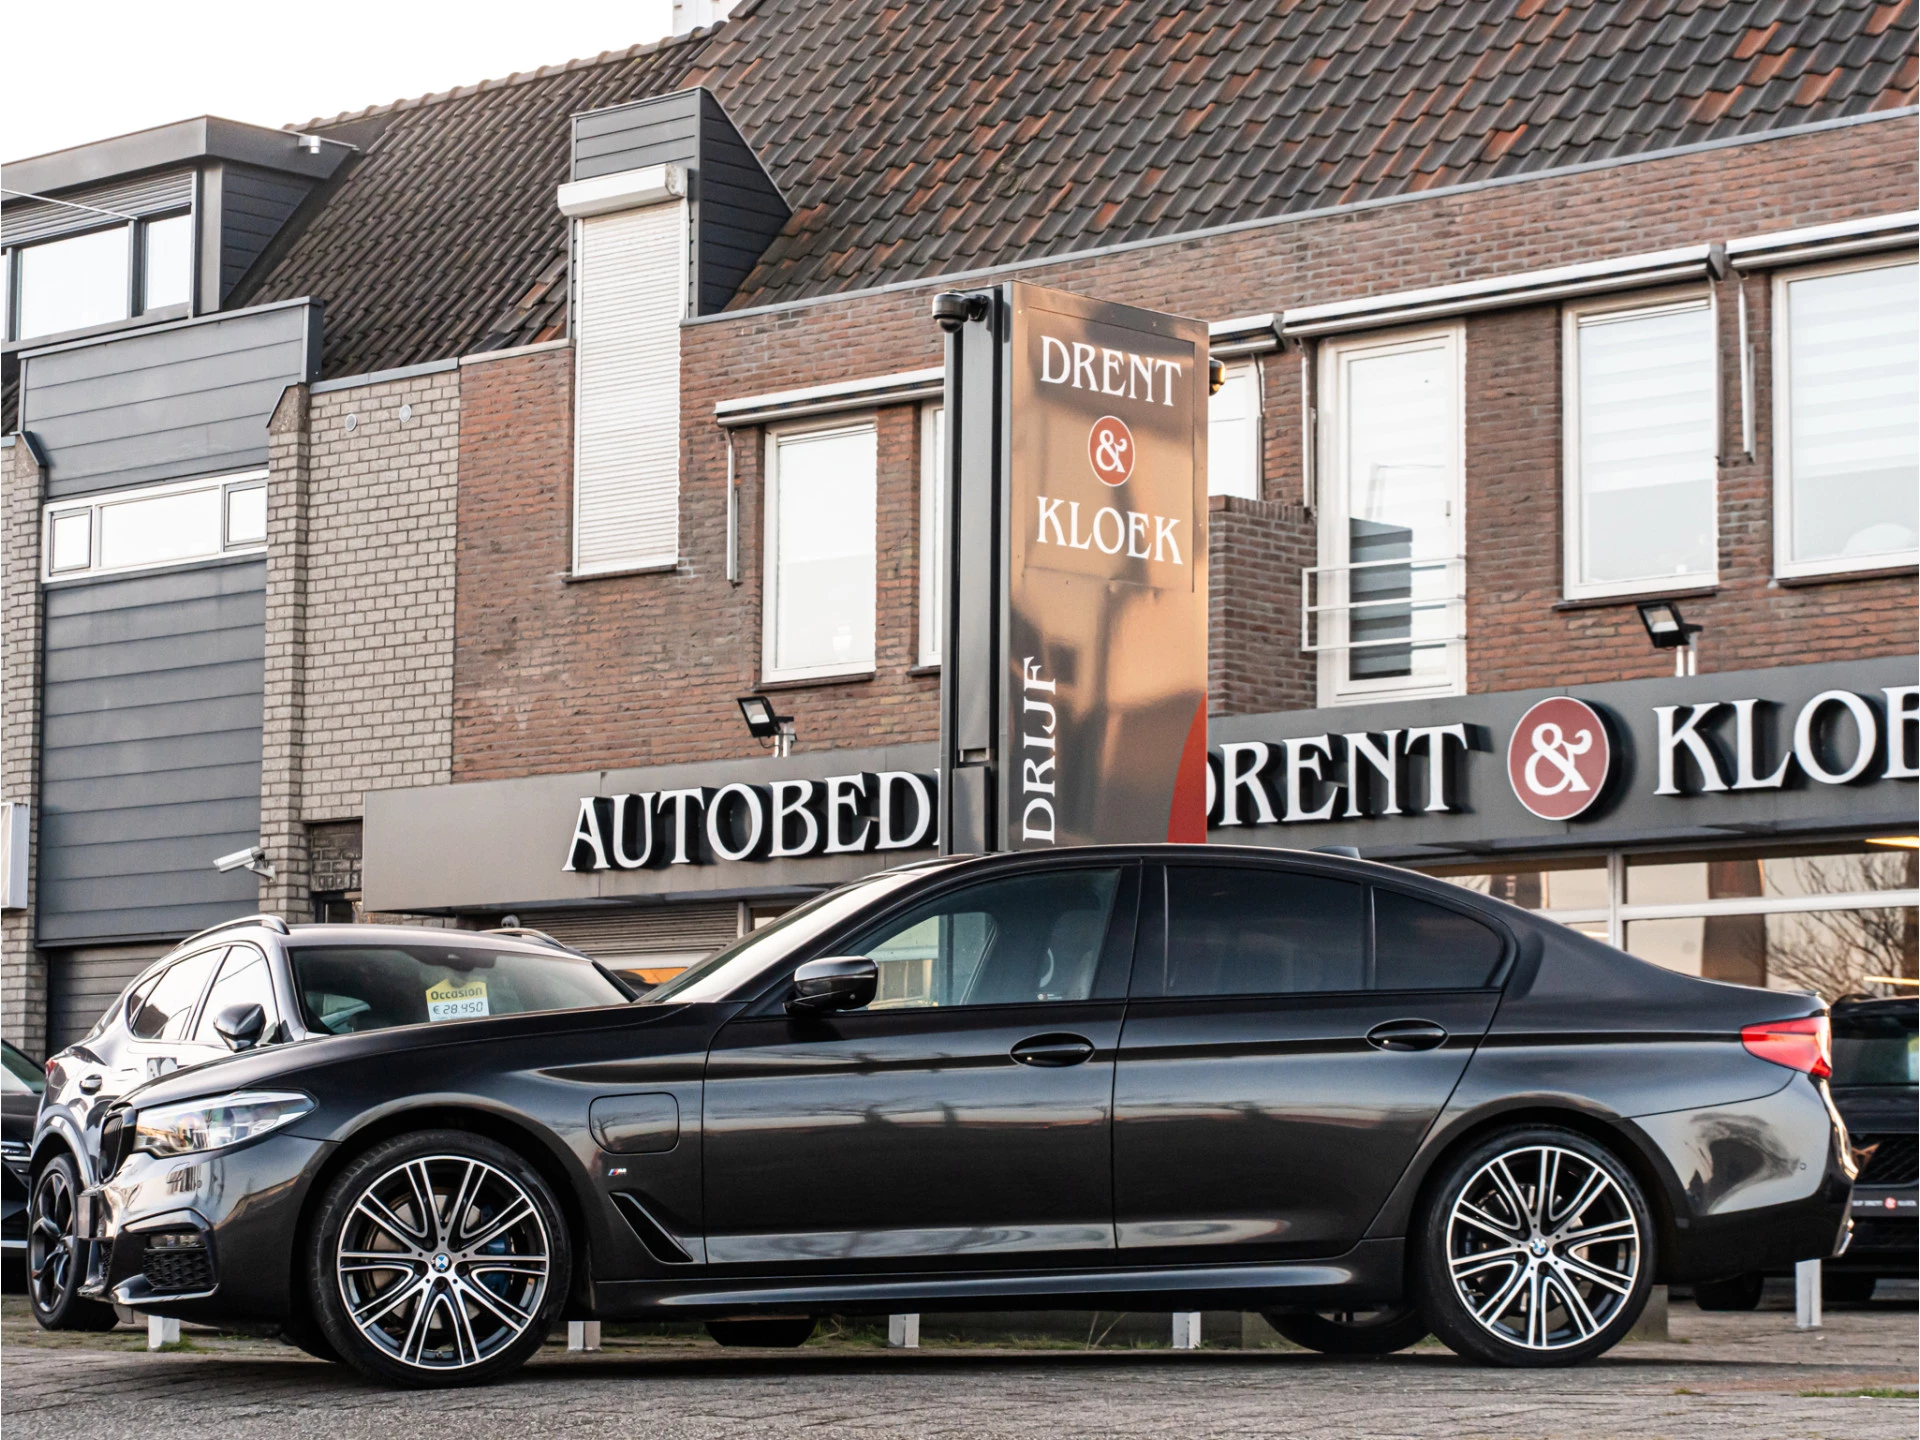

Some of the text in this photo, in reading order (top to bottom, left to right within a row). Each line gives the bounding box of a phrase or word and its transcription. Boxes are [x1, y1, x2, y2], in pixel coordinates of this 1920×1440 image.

[1040, 335, 1182, 406] DRENT
[1095, 429, 1128, 473] &
[1037, 496, 1183, 564] KLOEK
[1022, 656, 1057, 844] DRIJF
[562, 768, 939, 871] AUTOBED
[1206, 723, 1468, 826] RENT
[1524, 722, 1593, 796] &
[430, 987, 483, 1000] Occasion
[432, 1005, 440, 1015] €
